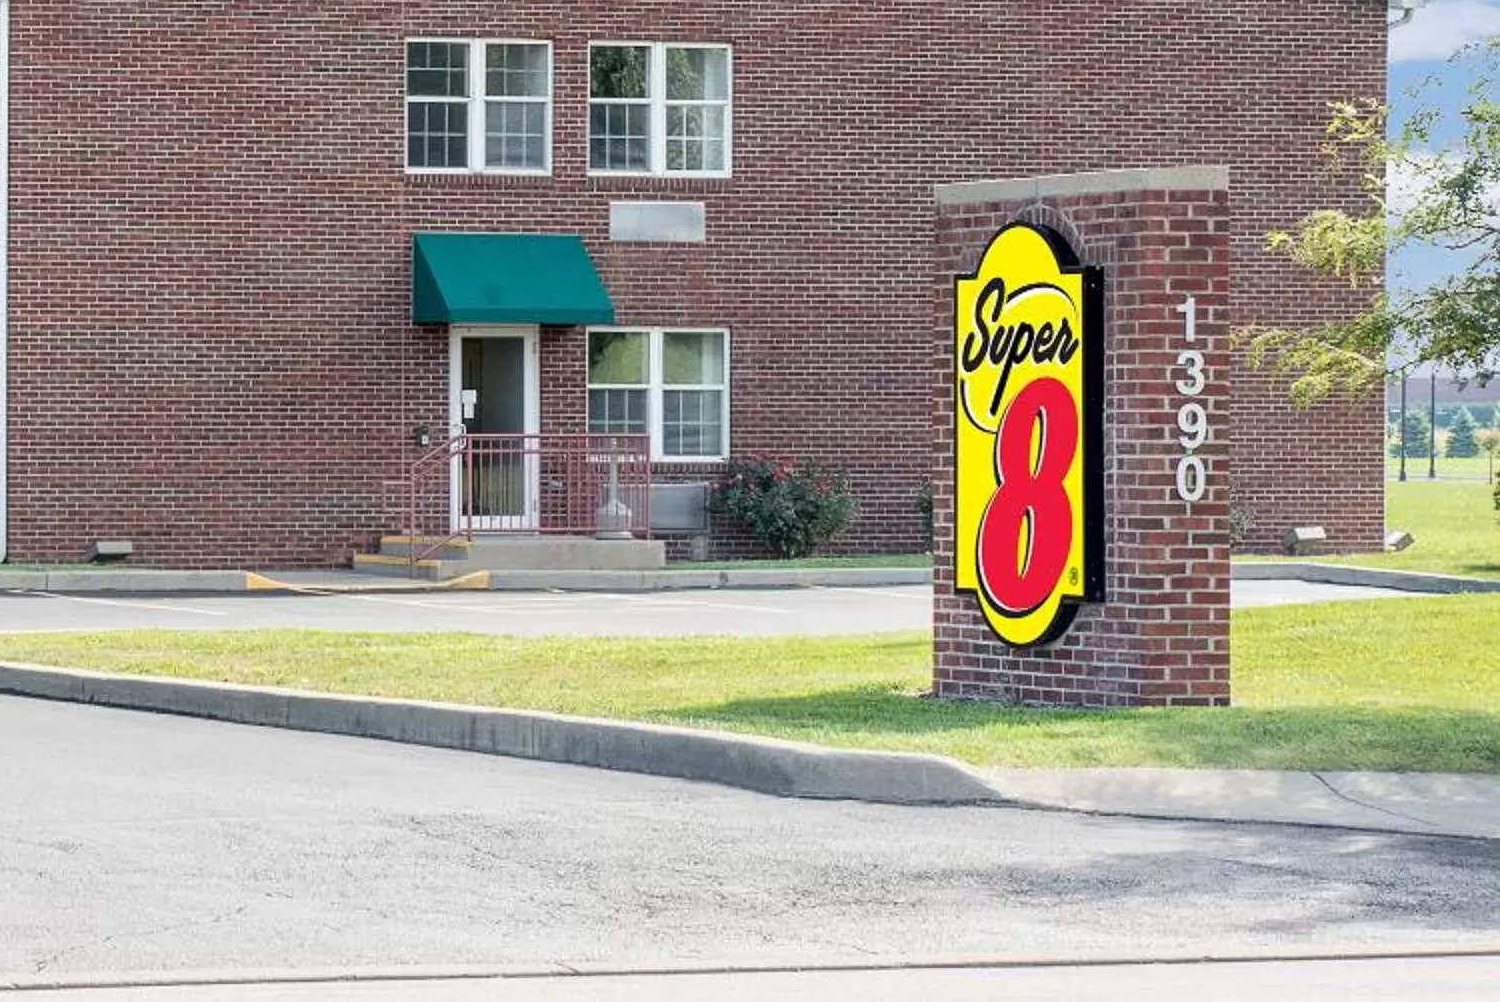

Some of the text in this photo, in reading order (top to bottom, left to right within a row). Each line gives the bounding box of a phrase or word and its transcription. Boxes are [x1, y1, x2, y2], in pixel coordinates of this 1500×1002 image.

[962, 277, 1079, 416] Super
[1175, 297, 1207, 502] 1390
[976, 376, 1078, 618] 8
